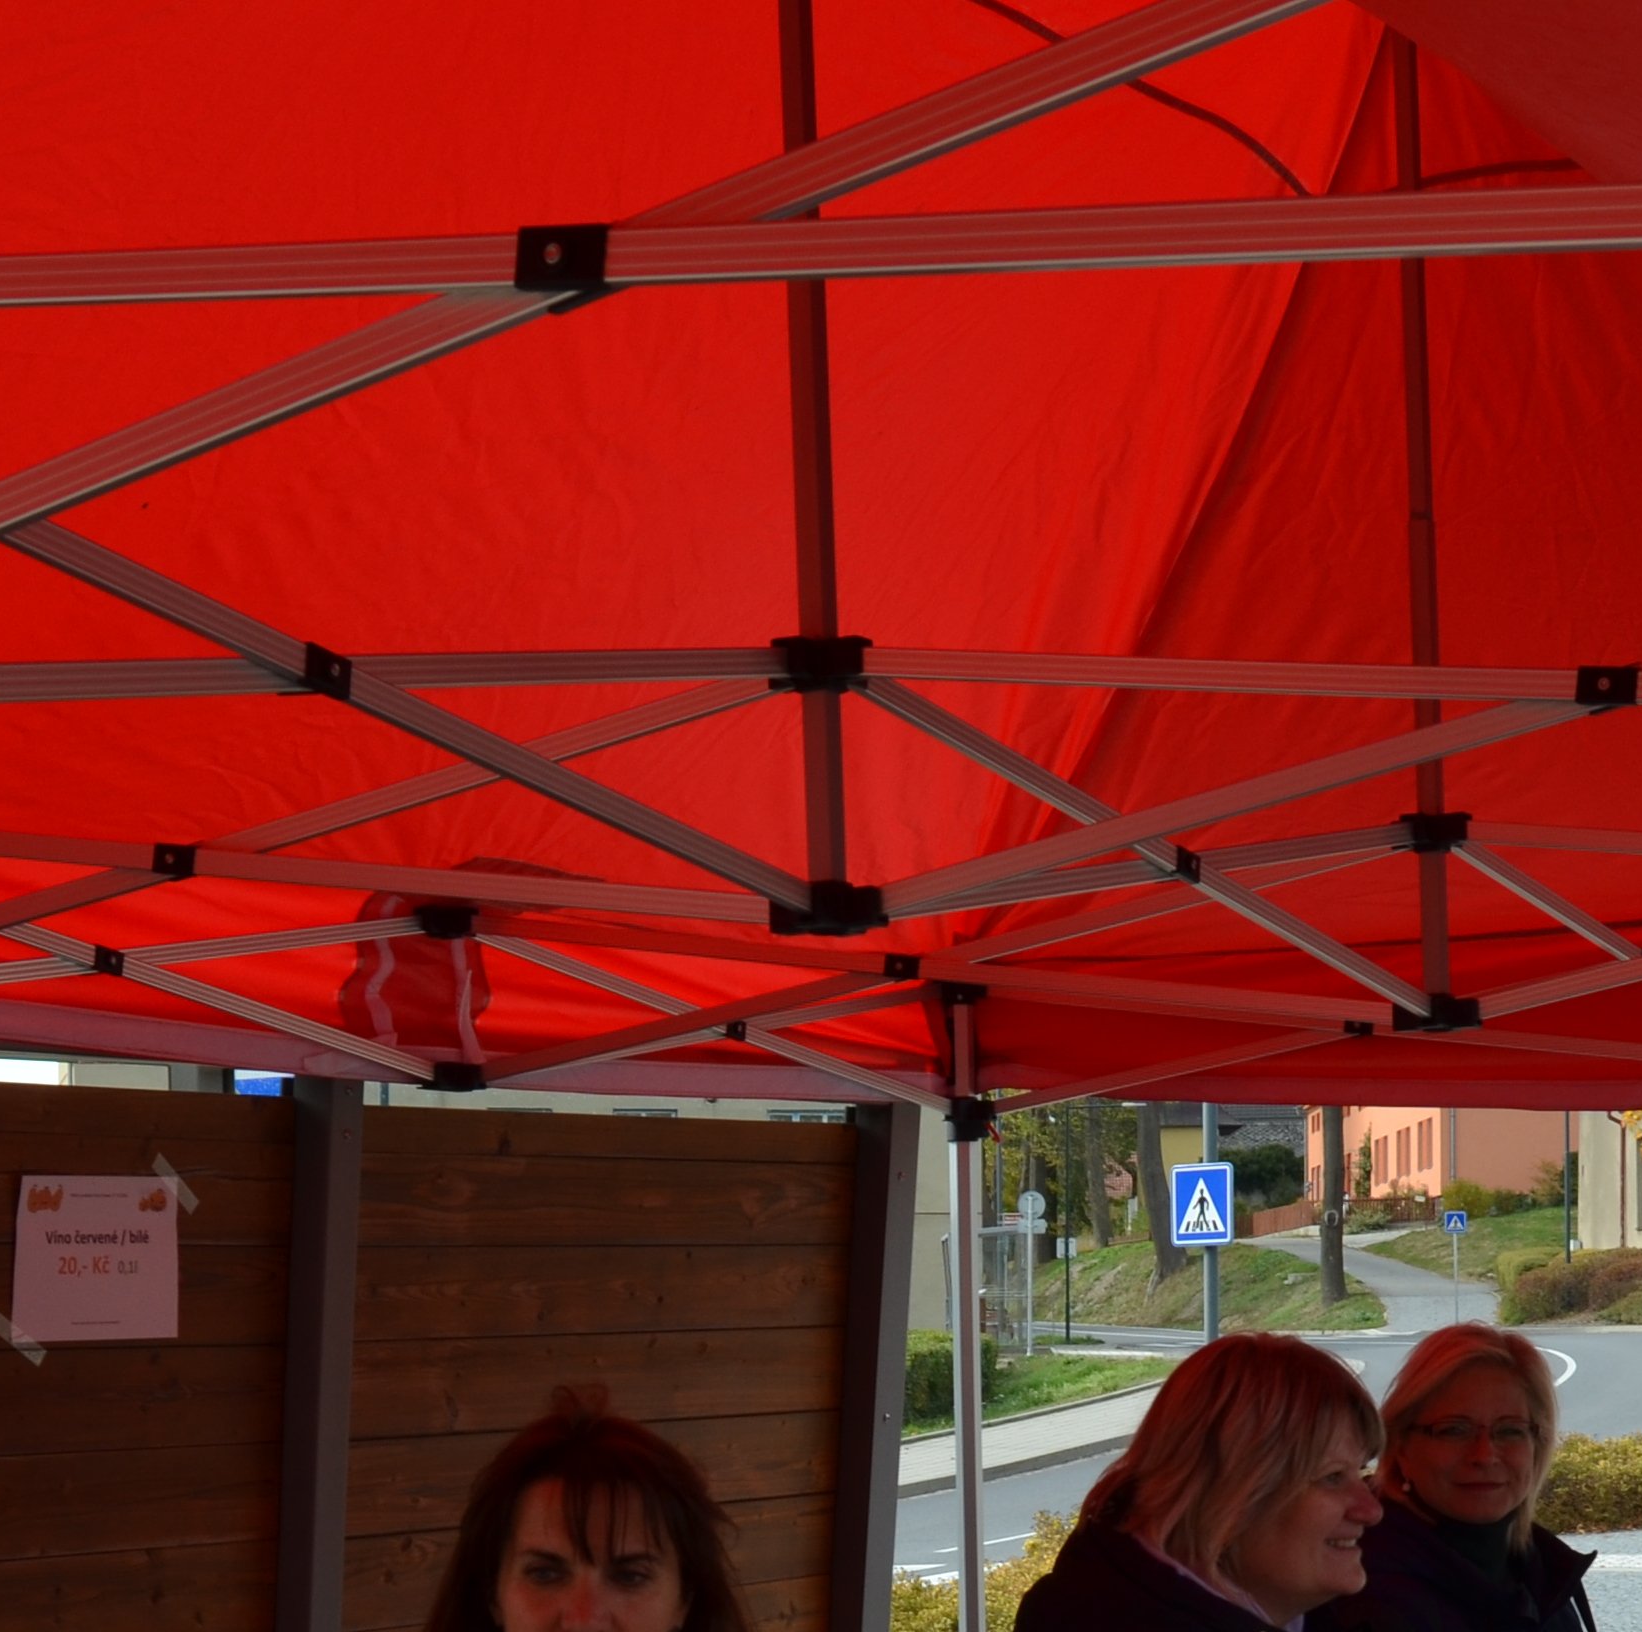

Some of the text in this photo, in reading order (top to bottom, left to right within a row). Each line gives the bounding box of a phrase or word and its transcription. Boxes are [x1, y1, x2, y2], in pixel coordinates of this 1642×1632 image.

[45, 1231, 71, 1244] Víno
[74, 1230, 118, 1244] červené
[129, 1230, 149, 1244] bílé
[58, 1257, 87, 1277] 20,-
[92, 1256, 110, 1274] Kč
